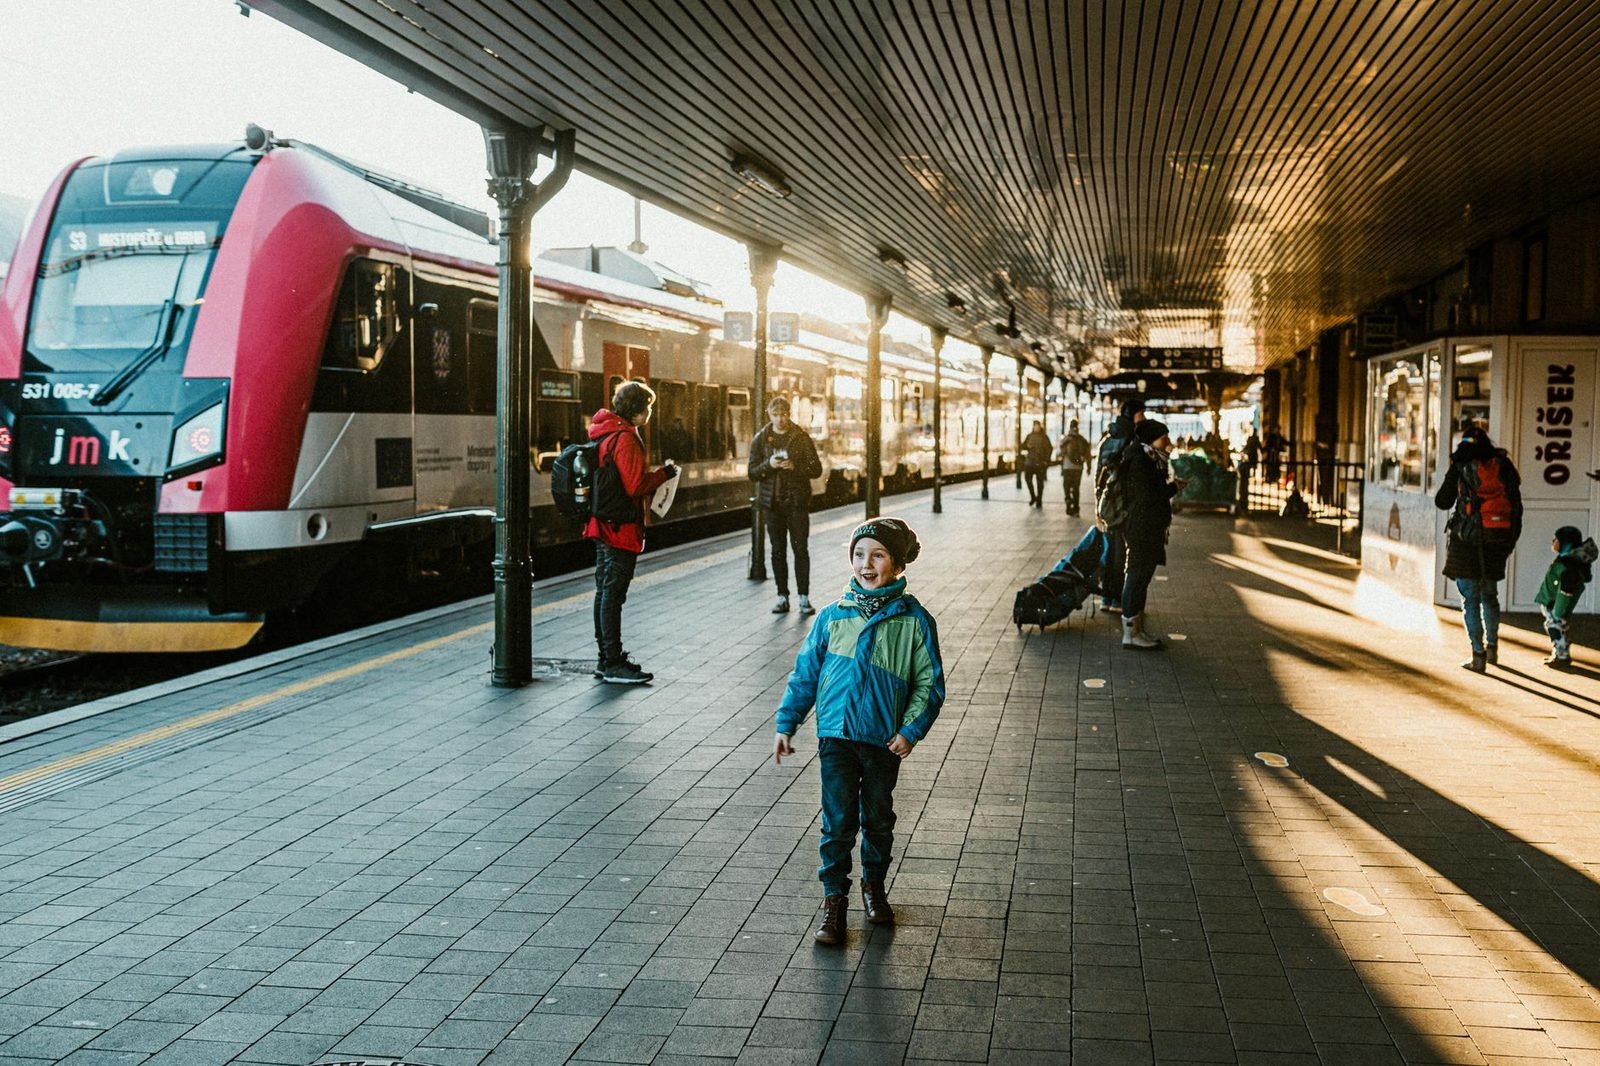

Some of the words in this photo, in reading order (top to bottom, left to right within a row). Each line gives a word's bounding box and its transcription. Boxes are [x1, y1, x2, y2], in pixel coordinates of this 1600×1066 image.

[69, 231, 87, 250] S3
[732, 322, 744, 340] 3
[21, 382, 50, 399] 531
[53, 382, 101, 399] 005-7
[1535, 364, 1575, 486] OŘÍŠEK
[49, 428, 131, 465] jmk
